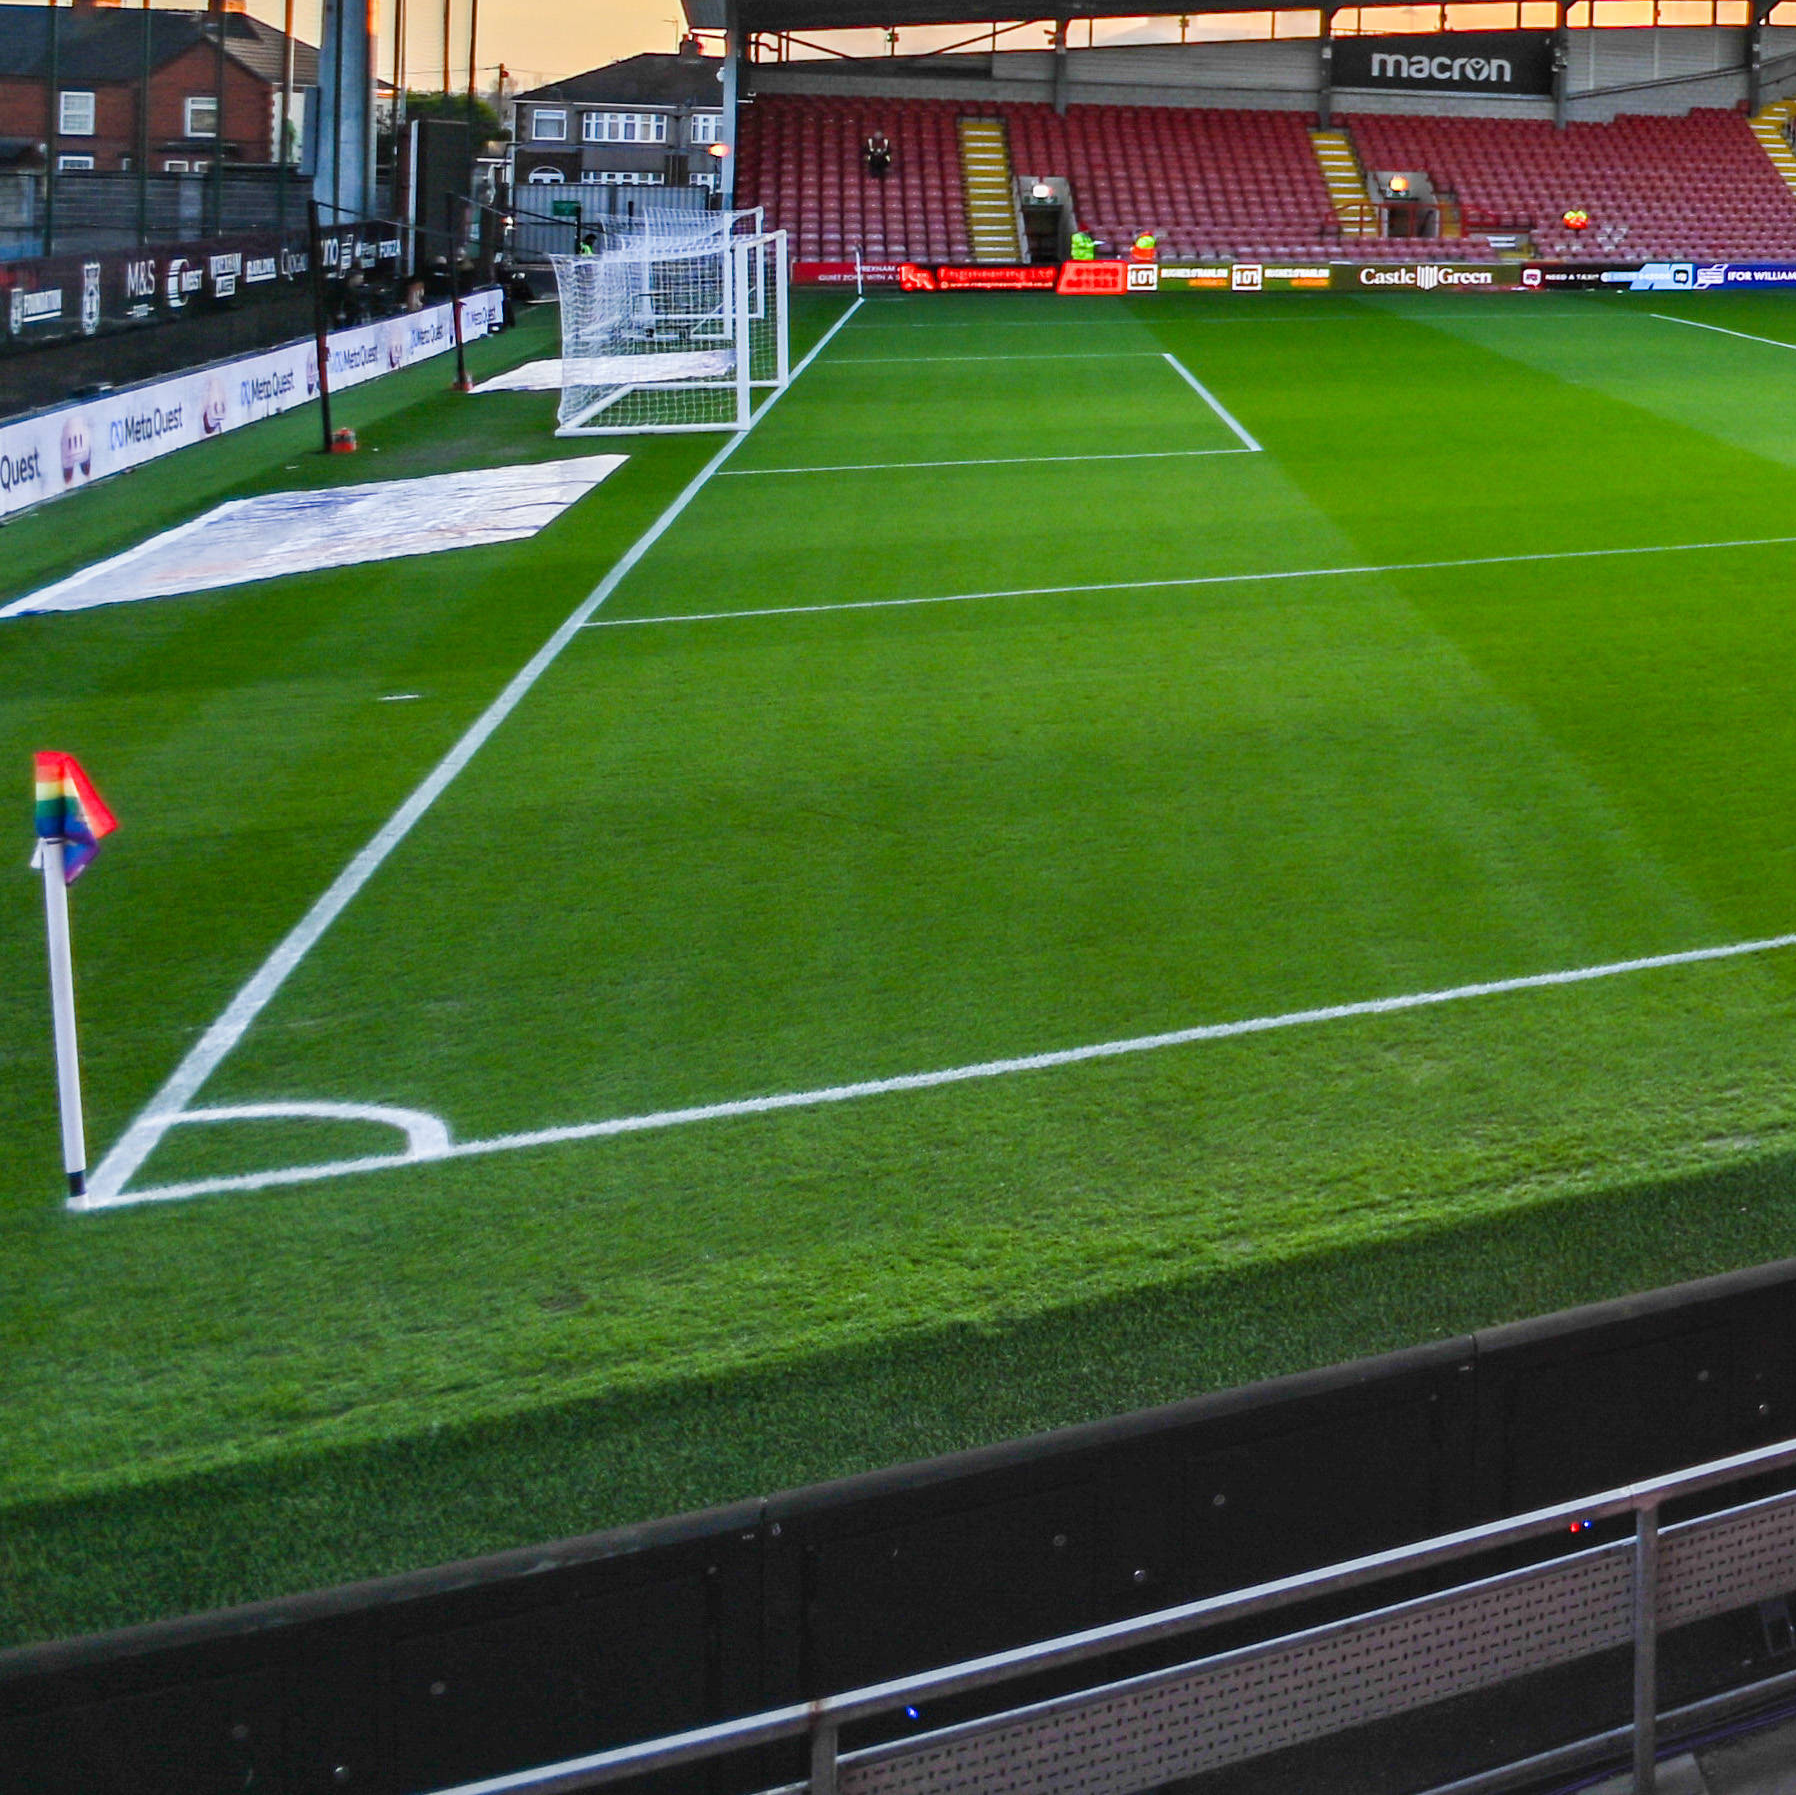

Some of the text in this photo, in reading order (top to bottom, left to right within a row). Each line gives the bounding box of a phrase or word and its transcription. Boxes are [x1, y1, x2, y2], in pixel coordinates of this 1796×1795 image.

[1371, 53, 1512, 82] macron
[127, 259, 156, 298] M&S
[1359, 267, 1492, 285] Castle Green
[1727, 271, 1752, 281] IFOR
[251, 371, 295, 403] Meta Quest
[124, 403, 183, 443] Meta Quest
[0, 446, 41, 492] Quest
